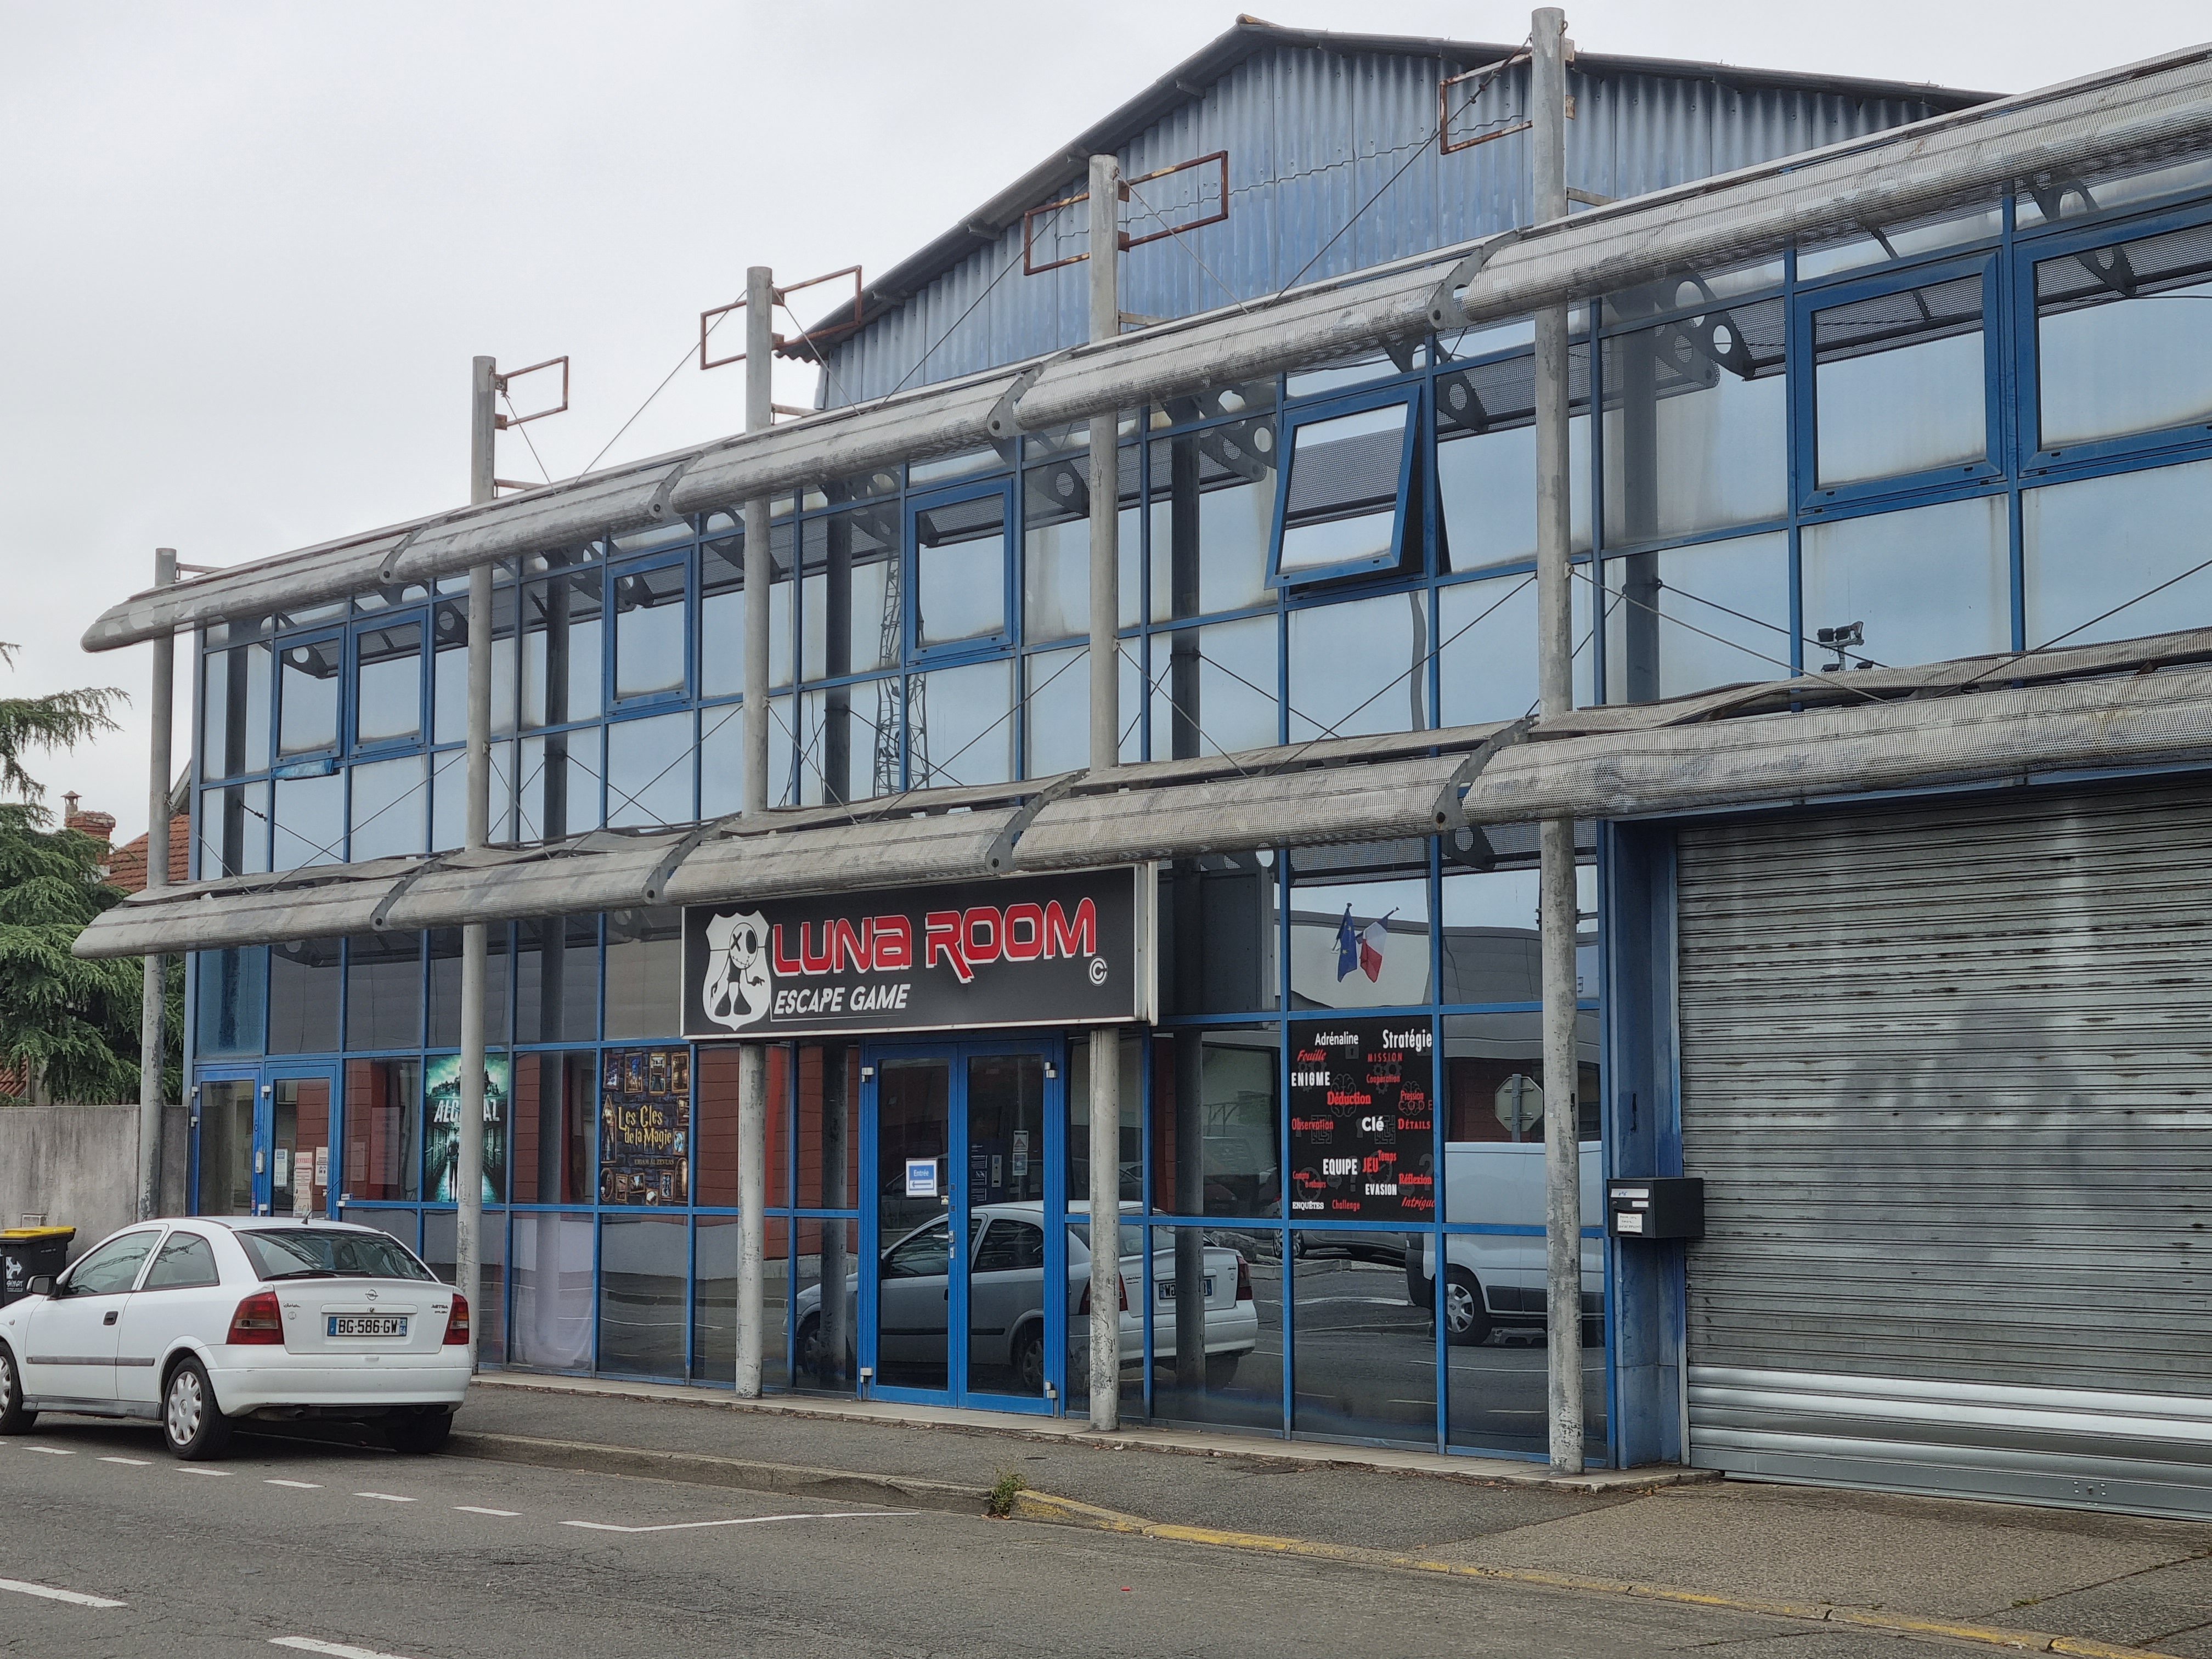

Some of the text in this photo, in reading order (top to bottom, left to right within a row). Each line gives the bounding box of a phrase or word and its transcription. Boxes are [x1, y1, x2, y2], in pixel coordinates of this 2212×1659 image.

[925, 897, 1096, 984] ROOM
[774, 984, 911, 1014] ESCAPE GAME
[1314, 1031, 1359, 1046] Adrénaline
[1383, 1028, 1432, 1052] Stratégie
[1297, 1048, 1327, 1062] Fouille
[1367, 1052, 1403, 1062] MISSION
[1291, 1071, 1331, 1087] ENIGME
[1327, 1091, 1372, 1105] Déduction
[1401, 1090, 1424, 1102] Pression
[433, 1098, 500, 1122] ALCAZ
[1398, 1099, 1433, 1111] CODE
[618, 1106, 636, 1131] Les
[1291, 1118, 1334, 1130] Observation
[1362, 1116, 1384, 1132] Clé
[624, 1127, 672, 1152] de la Magie
[1378, 1149, 1397, 1162] Temps
[1323, 1158, 1358, 1176] EQUIPE
[1362, 1157, 1379, 1173] JEU
[913, 1169, 929, 1177] Entrée
[1398, 1173, 1432, 1185] Réflexion
[1365, 1183, 1397, 1196] EVASION
[1292, 1200, 1324, 1211] ENQUÊTES
[1332, 1199, 1361, 1212] Challenge
[338, 1319, 398, 1334] BG-586-GW
[399, 1327, 406, 1335] 64
